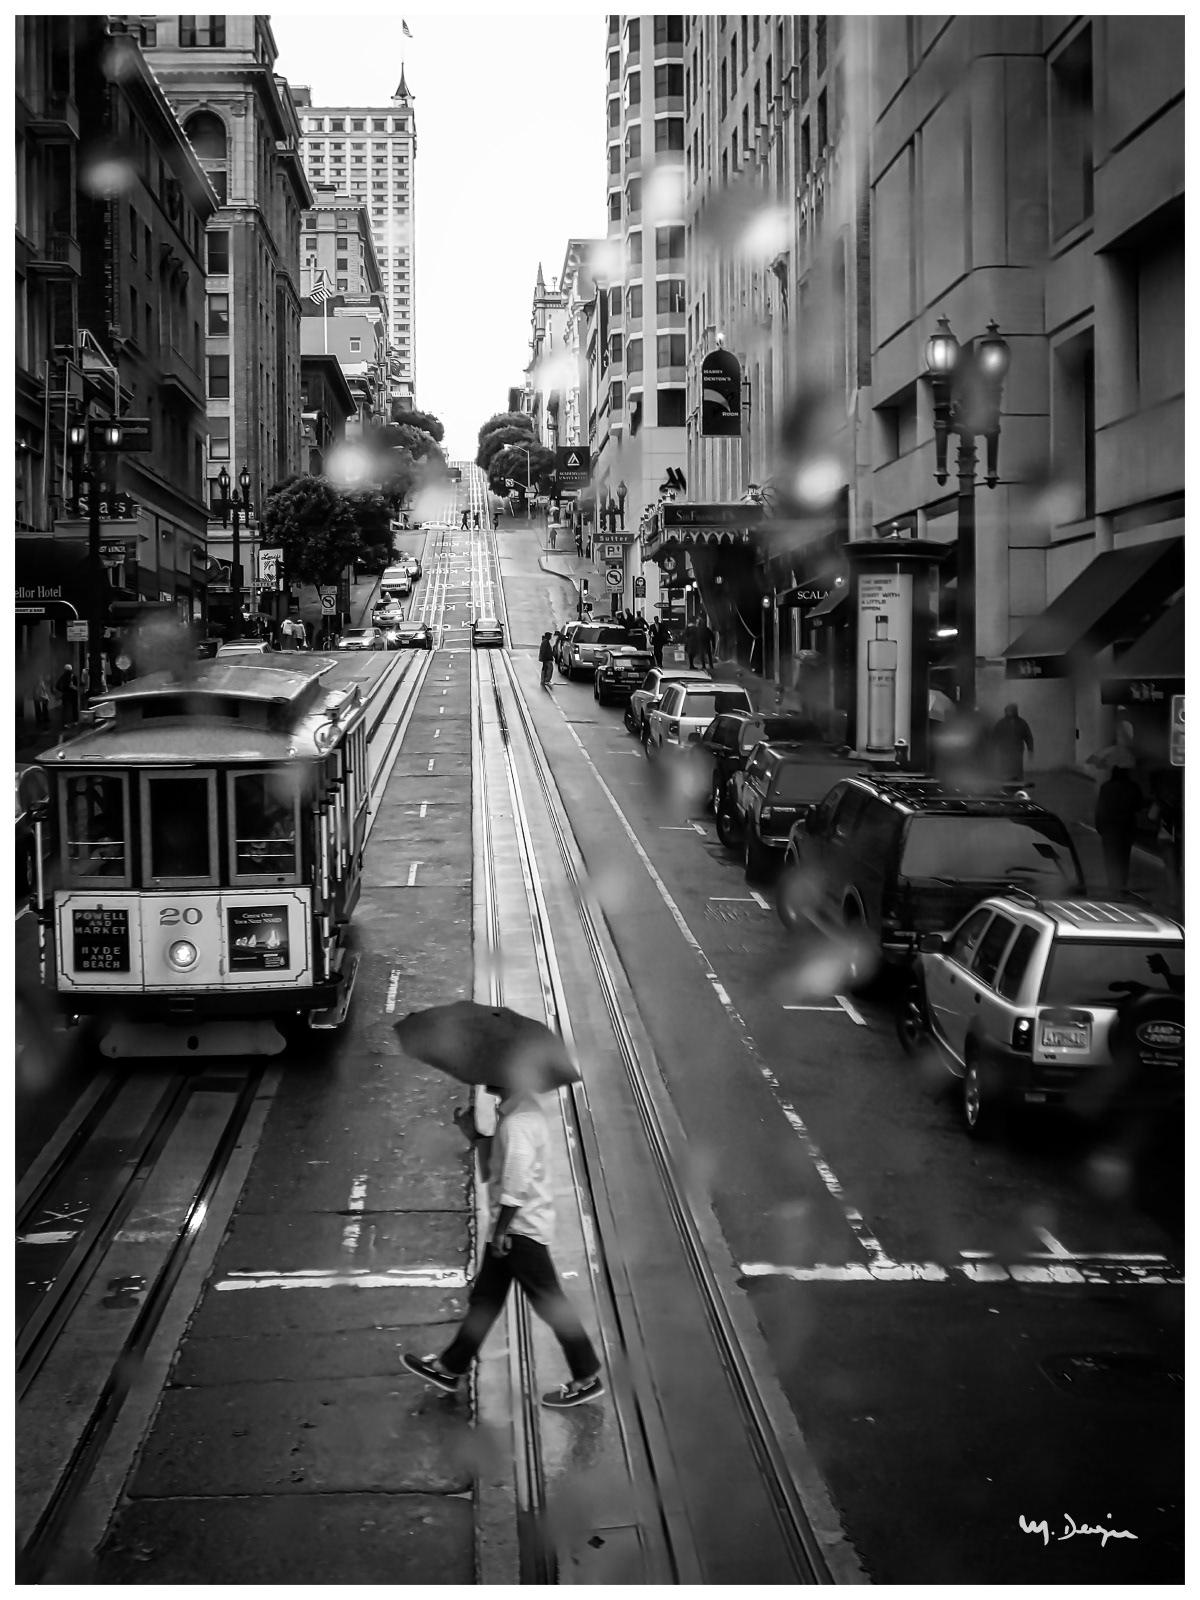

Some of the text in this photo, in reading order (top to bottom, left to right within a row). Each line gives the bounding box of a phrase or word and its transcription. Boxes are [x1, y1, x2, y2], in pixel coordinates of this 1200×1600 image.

[78, 496, 126, 514] Sas
[37, 586, 62, 598] Hotel
[75, 912, 126, 920] POWELL
[160, 907, 203, 926] 20
[74, 926, 126, 934] MARKET
[81, 946, 121, 954] HYDE
[83, 960, 120, 968] BEACH
